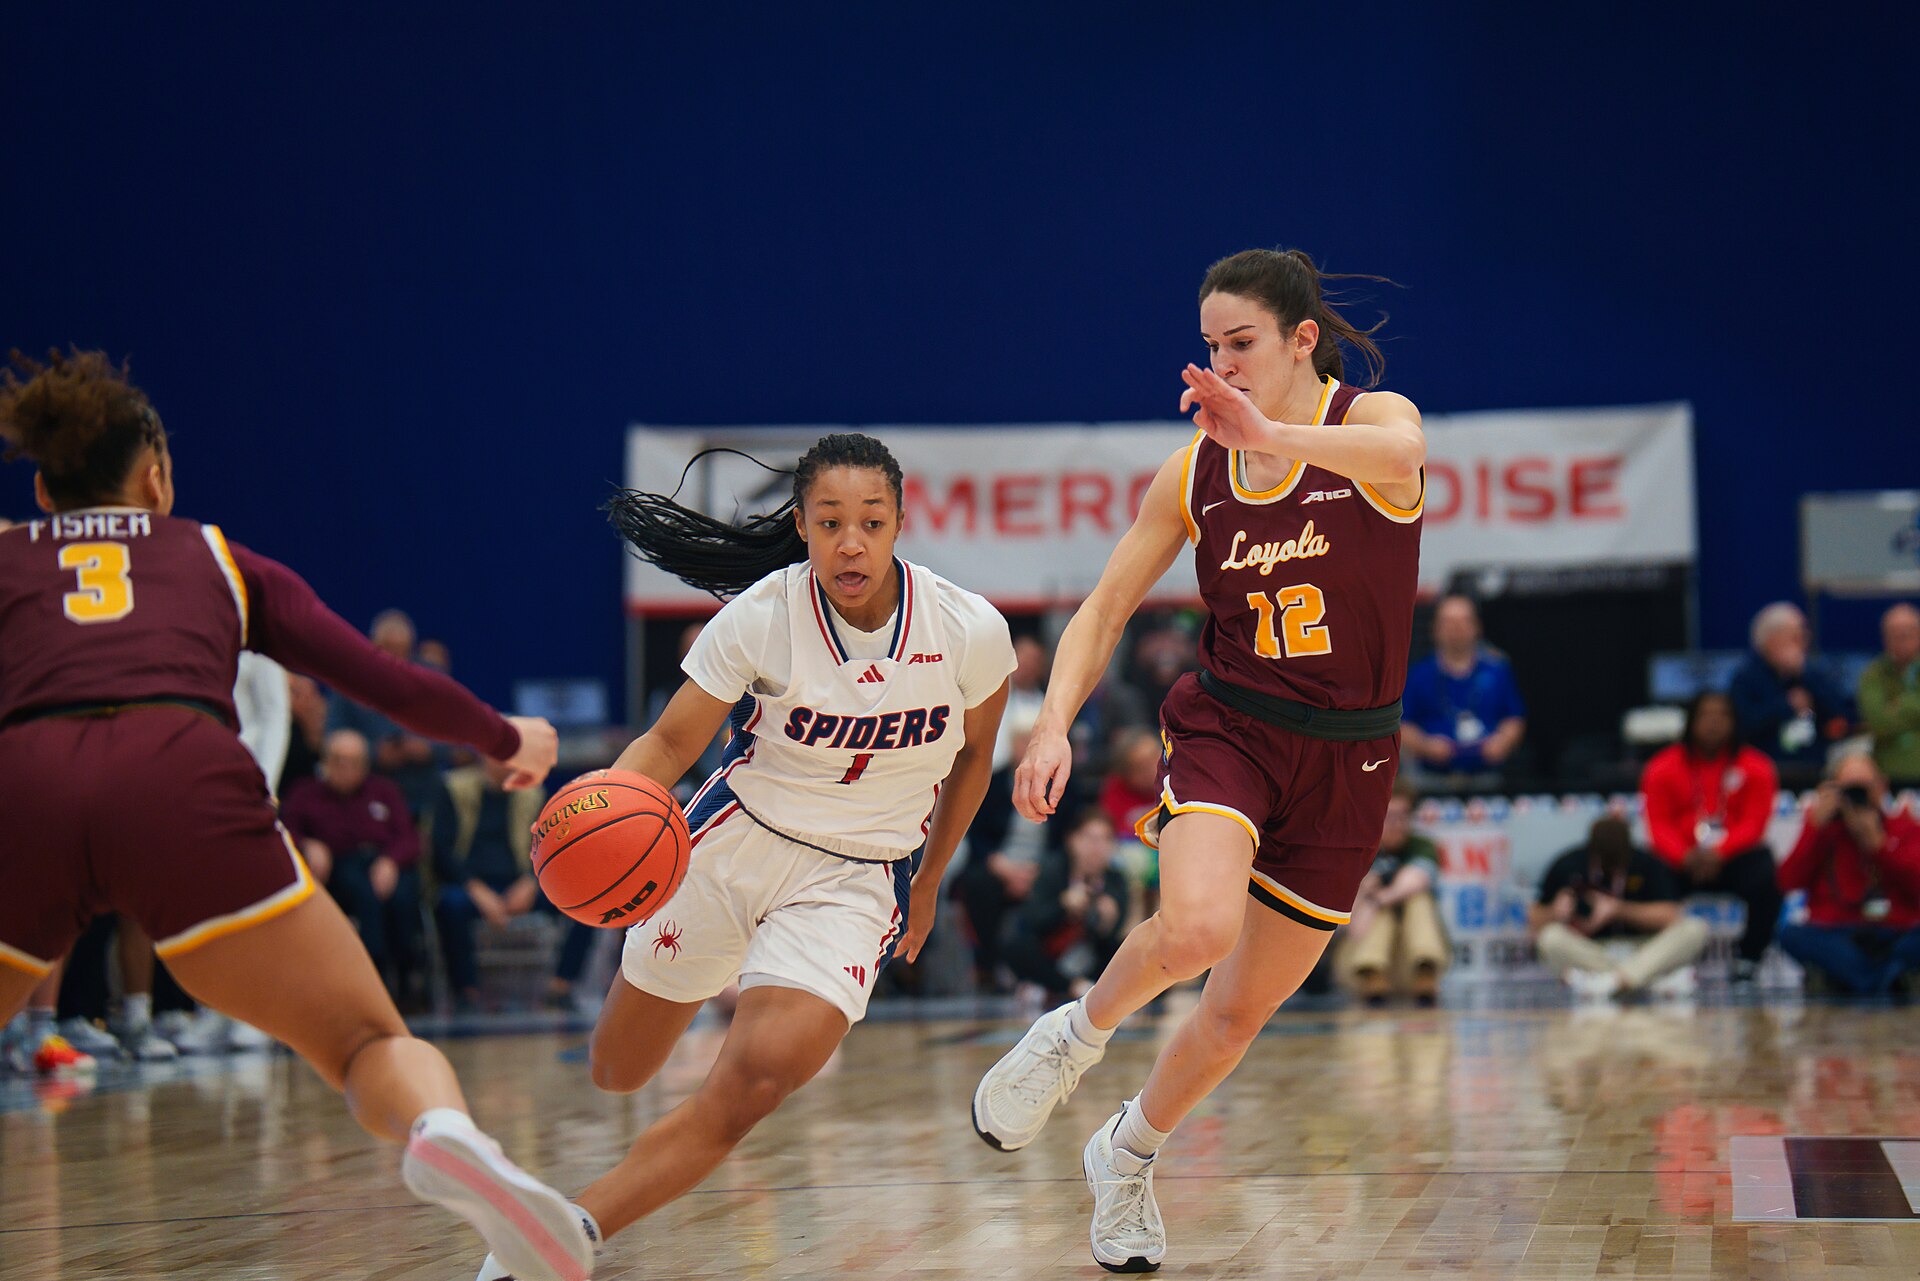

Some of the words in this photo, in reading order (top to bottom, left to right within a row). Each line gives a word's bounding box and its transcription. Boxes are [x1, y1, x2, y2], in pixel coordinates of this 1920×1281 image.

[902, 456, 1625, 535] MERDISE
[1220, 519, 1330, 576] Loyola
[57, 541, 135, 626] 3
[1246, 582, 1333, 660] 12
[783, 704, 951, 750] SPIDERS
[835, 753, 875, 785] 1
